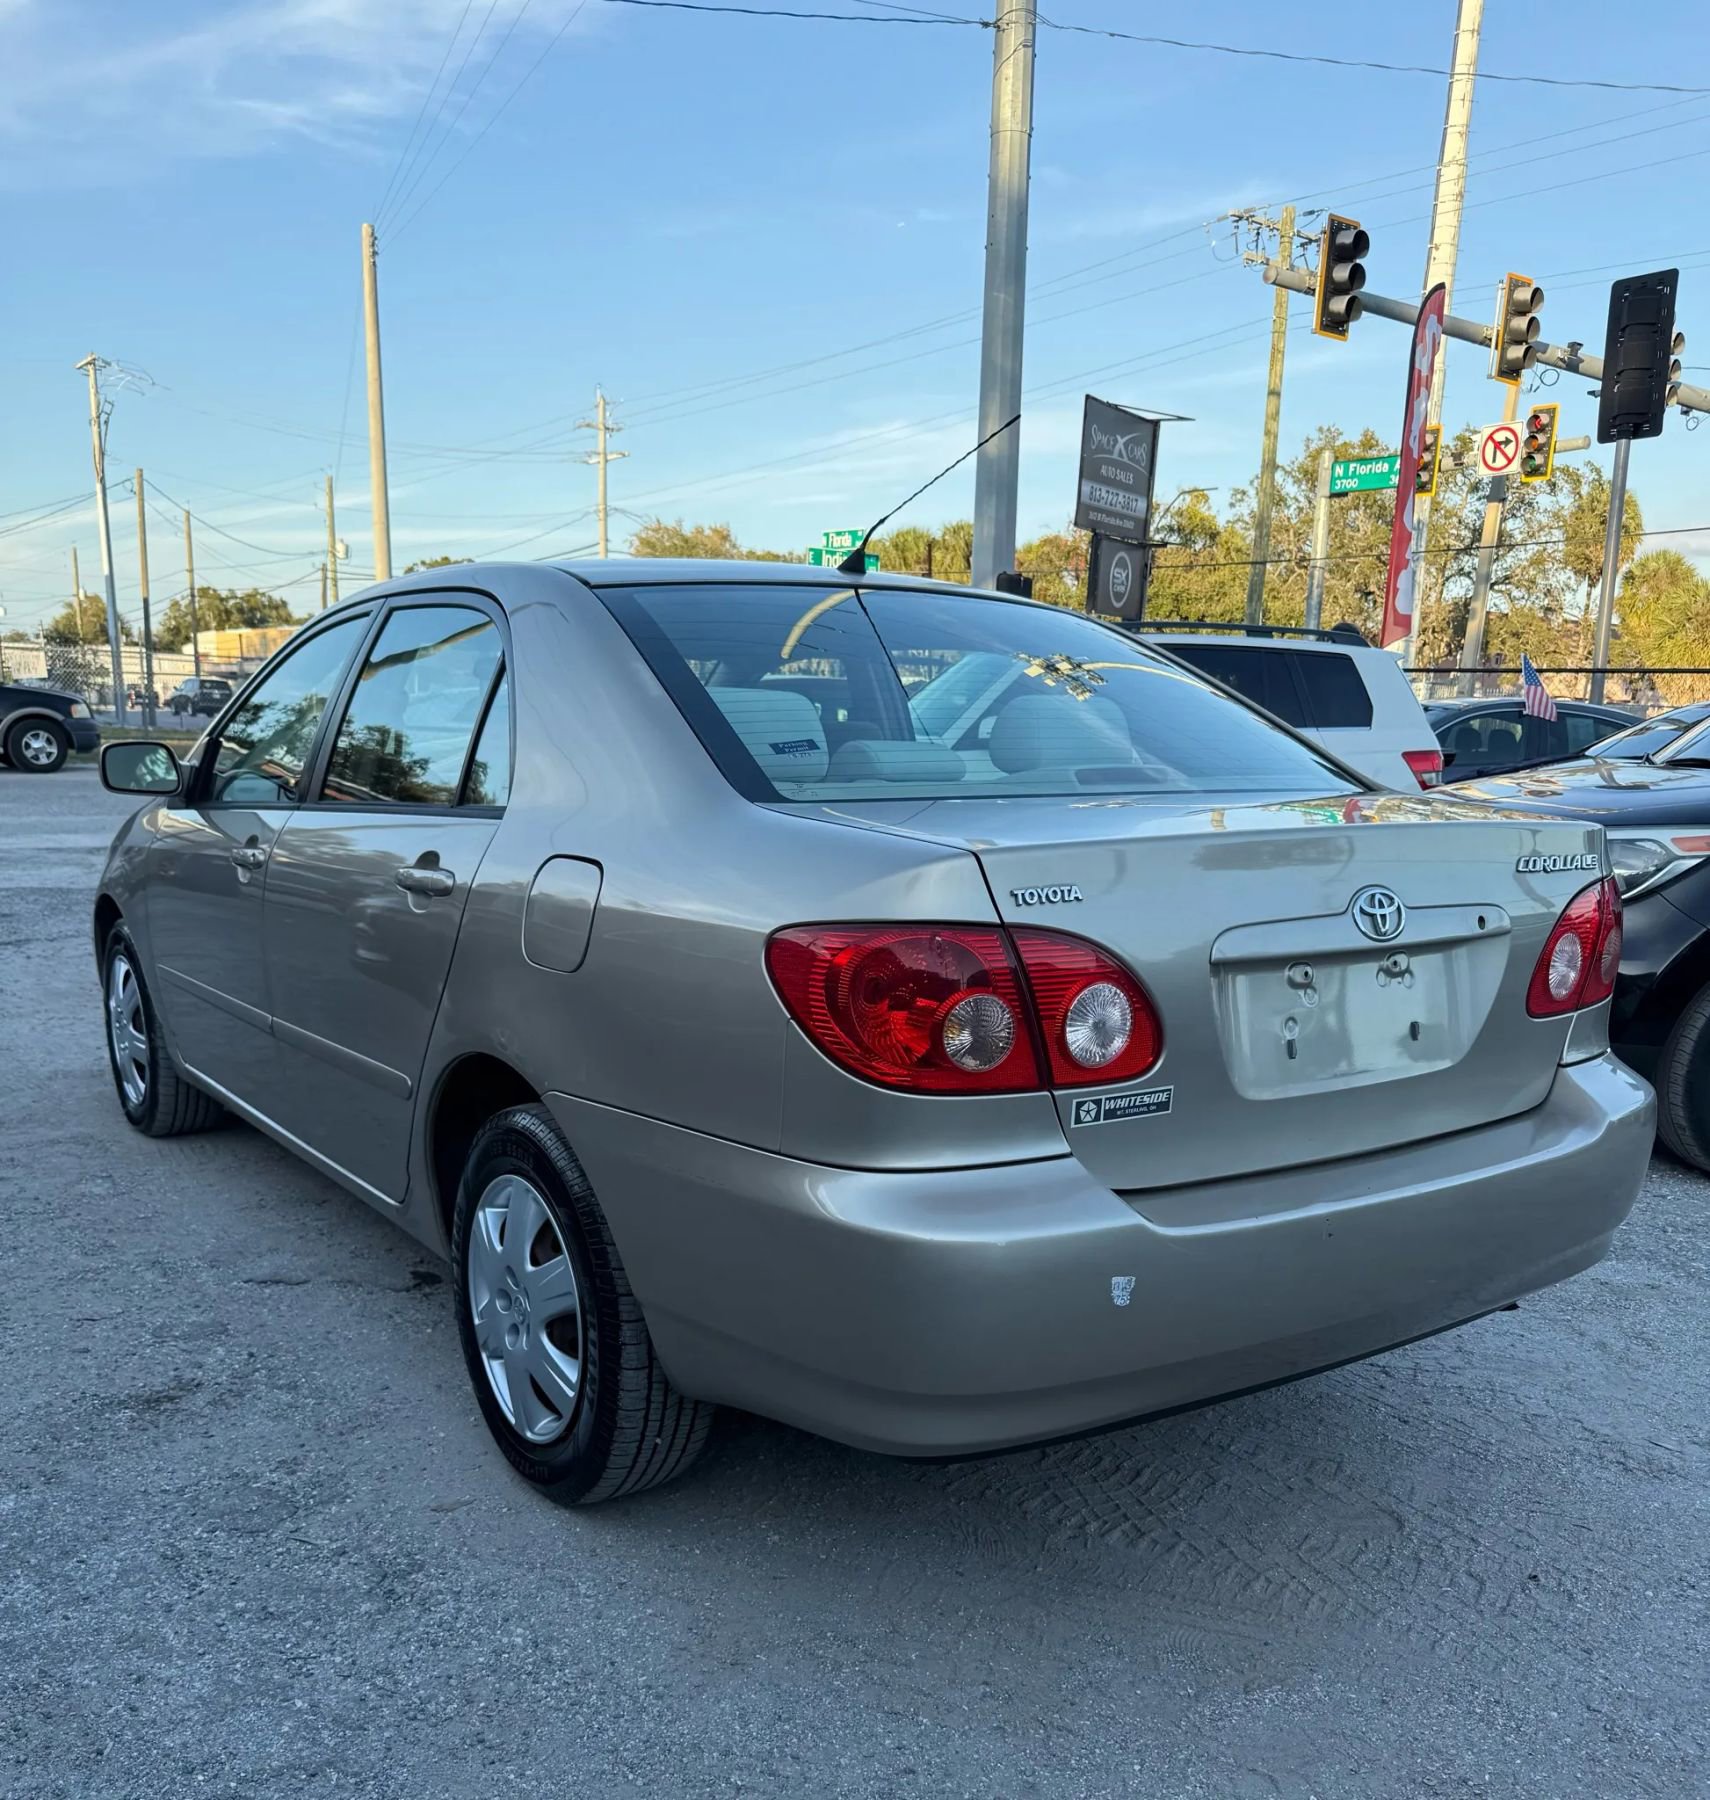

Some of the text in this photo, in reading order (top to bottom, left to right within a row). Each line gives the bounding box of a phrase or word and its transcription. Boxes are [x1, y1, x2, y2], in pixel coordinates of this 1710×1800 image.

[1091, 424, 1115, 450] SPACE
[1127, 443, 1148, 467] CARS
[1101, 465, 1134, 485] AUTO SALES
[1334, 464, 1344, 477] N
[1348, 461, 1389, 476] Florida
[1334, 478, 1359, 489] 3700
[808, 551, 815, 564] E
[1516, 855, 1581, 873] COROLLA
[1011, 885, 1084, 906] TOYOTA
[1105, 1091, 1170, 1109] WHITESIDE
